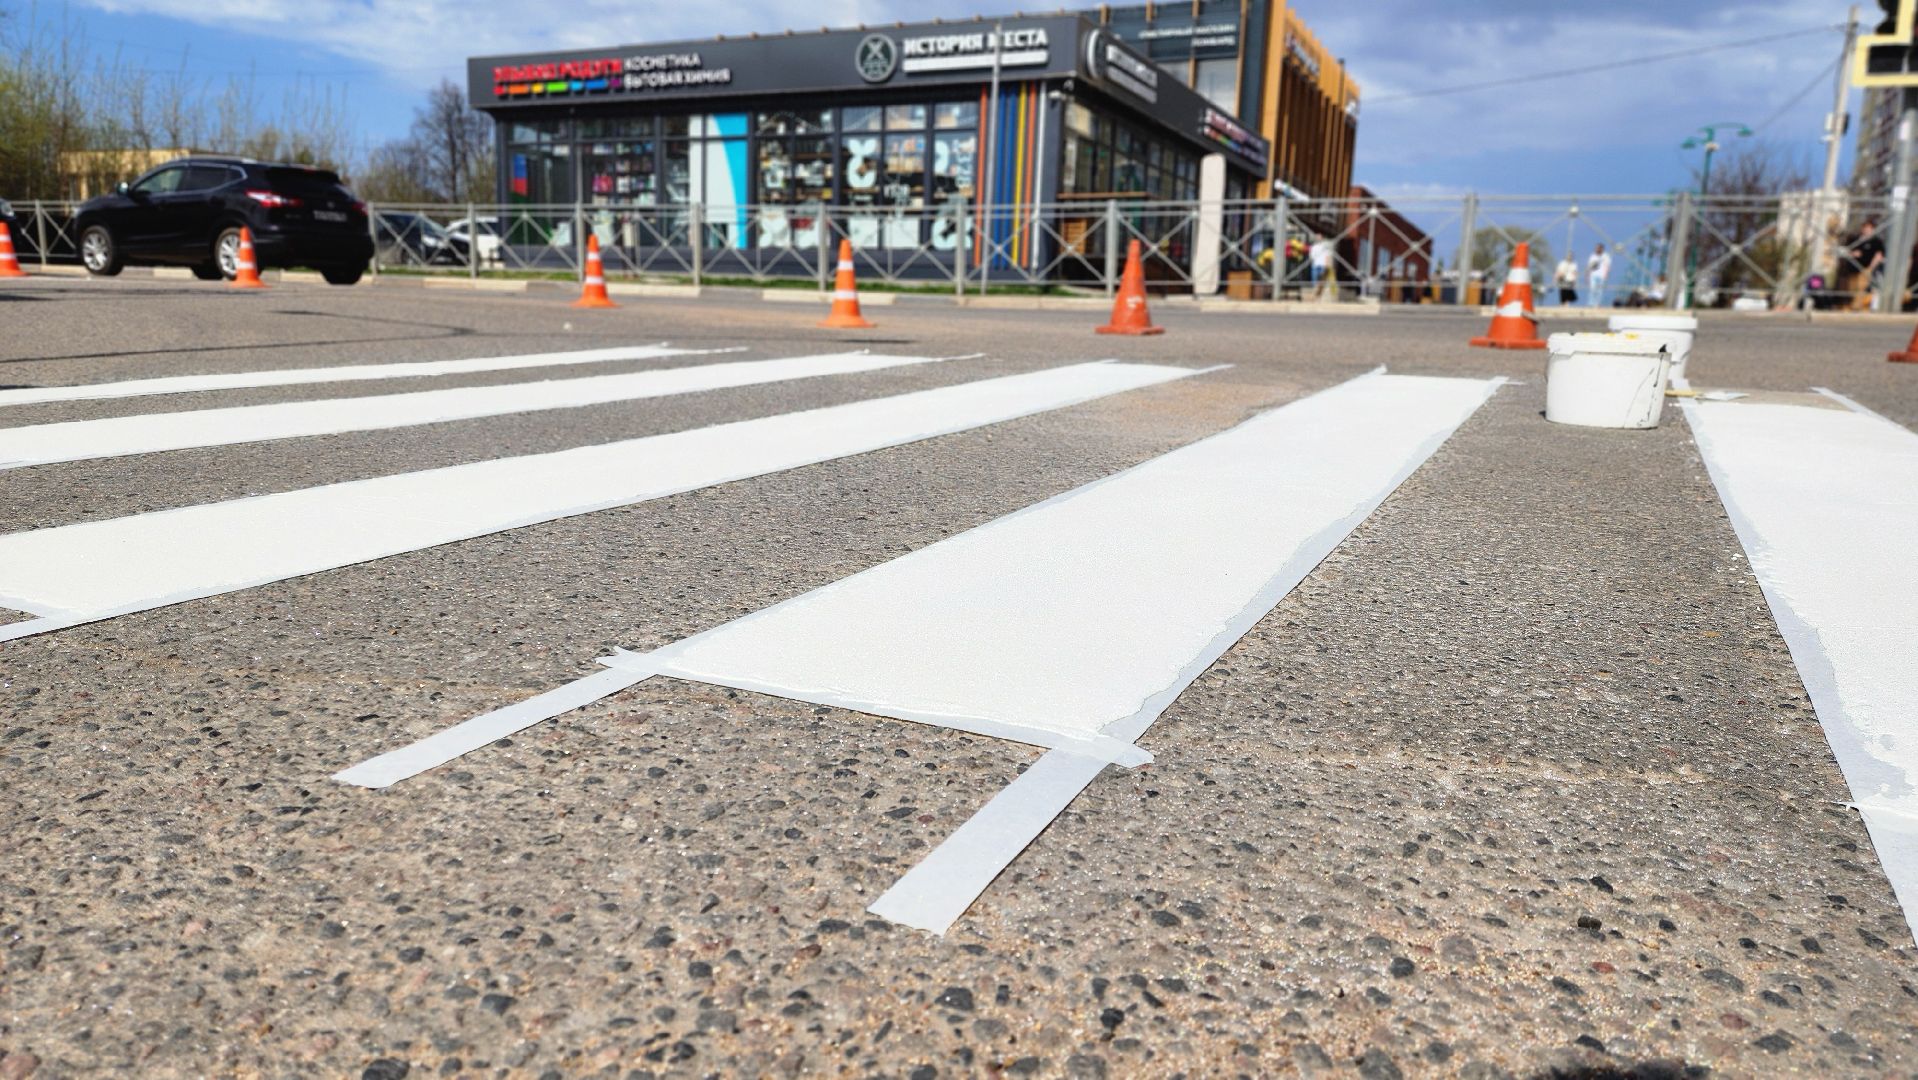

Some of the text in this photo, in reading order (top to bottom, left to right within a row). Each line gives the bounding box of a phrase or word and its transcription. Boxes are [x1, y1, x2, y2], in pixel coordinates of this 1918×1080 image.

[904, 33, 983, 55] ИСТОРИЯ
[624, 53, 701, 70] КОСМЕТИКА
[624, 68, 731, 89] БЫТОВАЯ ХИМИЯ
